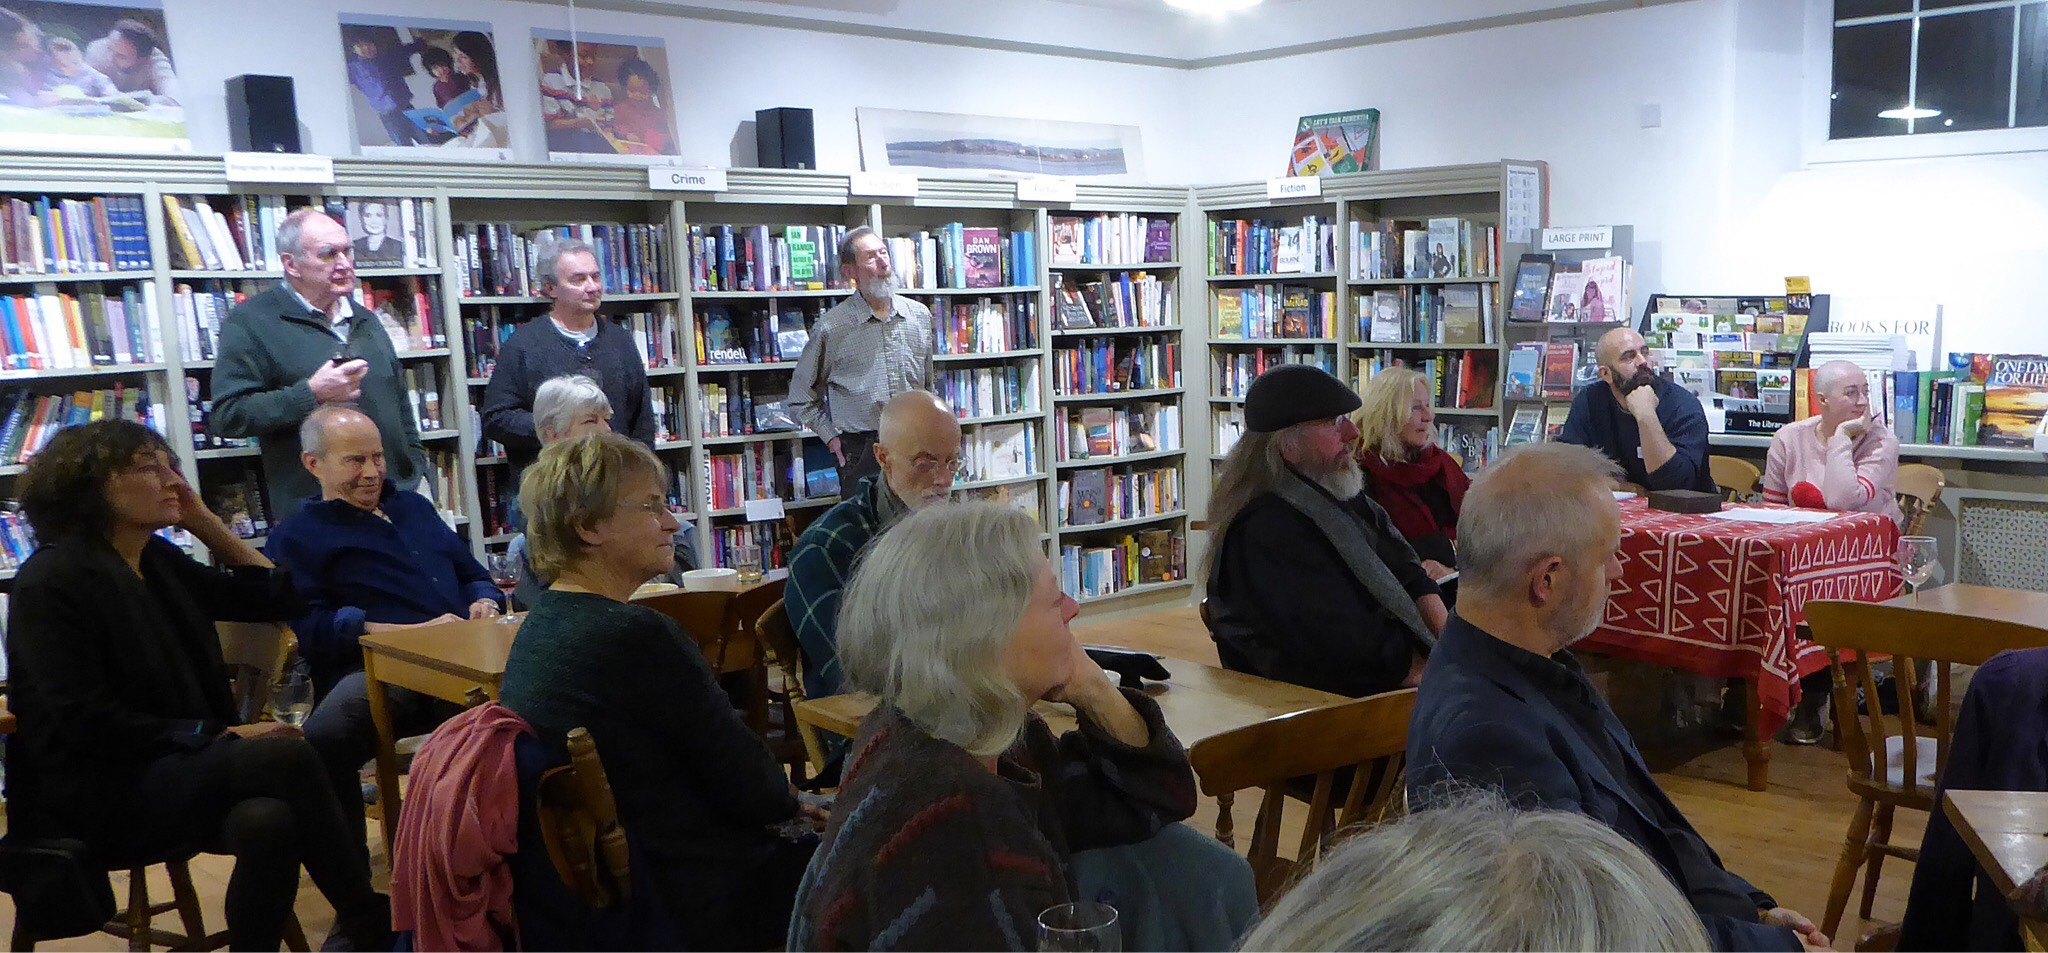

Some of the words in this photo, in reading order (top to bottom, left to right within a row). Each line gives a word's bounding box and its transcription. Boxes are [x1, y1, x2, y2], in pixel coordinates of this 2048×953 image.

[671, 173, 706, 185] Crime
[1280, 183, 1307, 193] Fiction
[1548, 233, 1577, 243] LARGE
[1578, 232, 1605, 242] PRINT
[966, 244, 997, 254] BROWN
[1830, 320, 1888, 334] BOOKS
[1894, 320, 1930, 335] FOR
[710, 347, 748, 360] rendell
[1994, 371, 2021, 385] FOR
[1748, 419, 1761, 428] The
